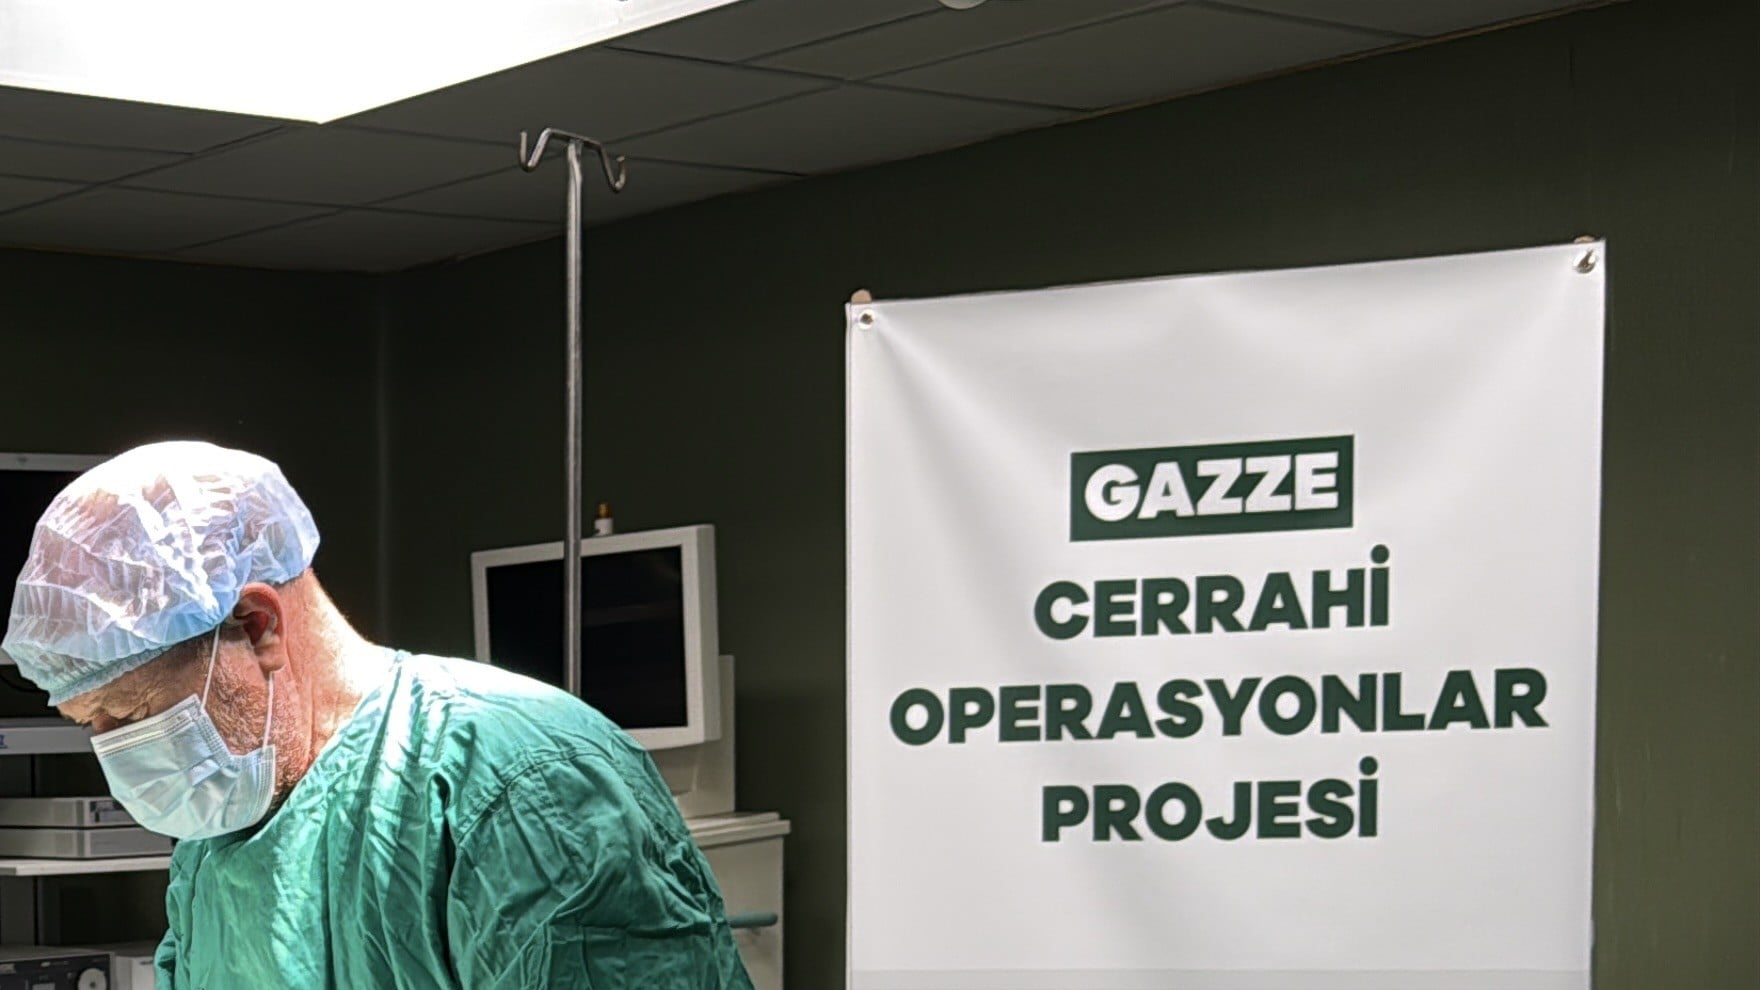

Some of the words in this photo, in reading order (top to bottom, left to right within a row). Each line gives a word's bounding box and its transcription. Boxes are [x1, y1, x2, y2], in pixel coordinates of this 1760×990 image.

[1084, 451, 1340, 522] GAZZE
[1033, 544, 1390, 640] CERRAHİ
[889, 667, 1549, 746] OPERASYONLAR
[1042, 756, 1379, 842] PROJESİ
